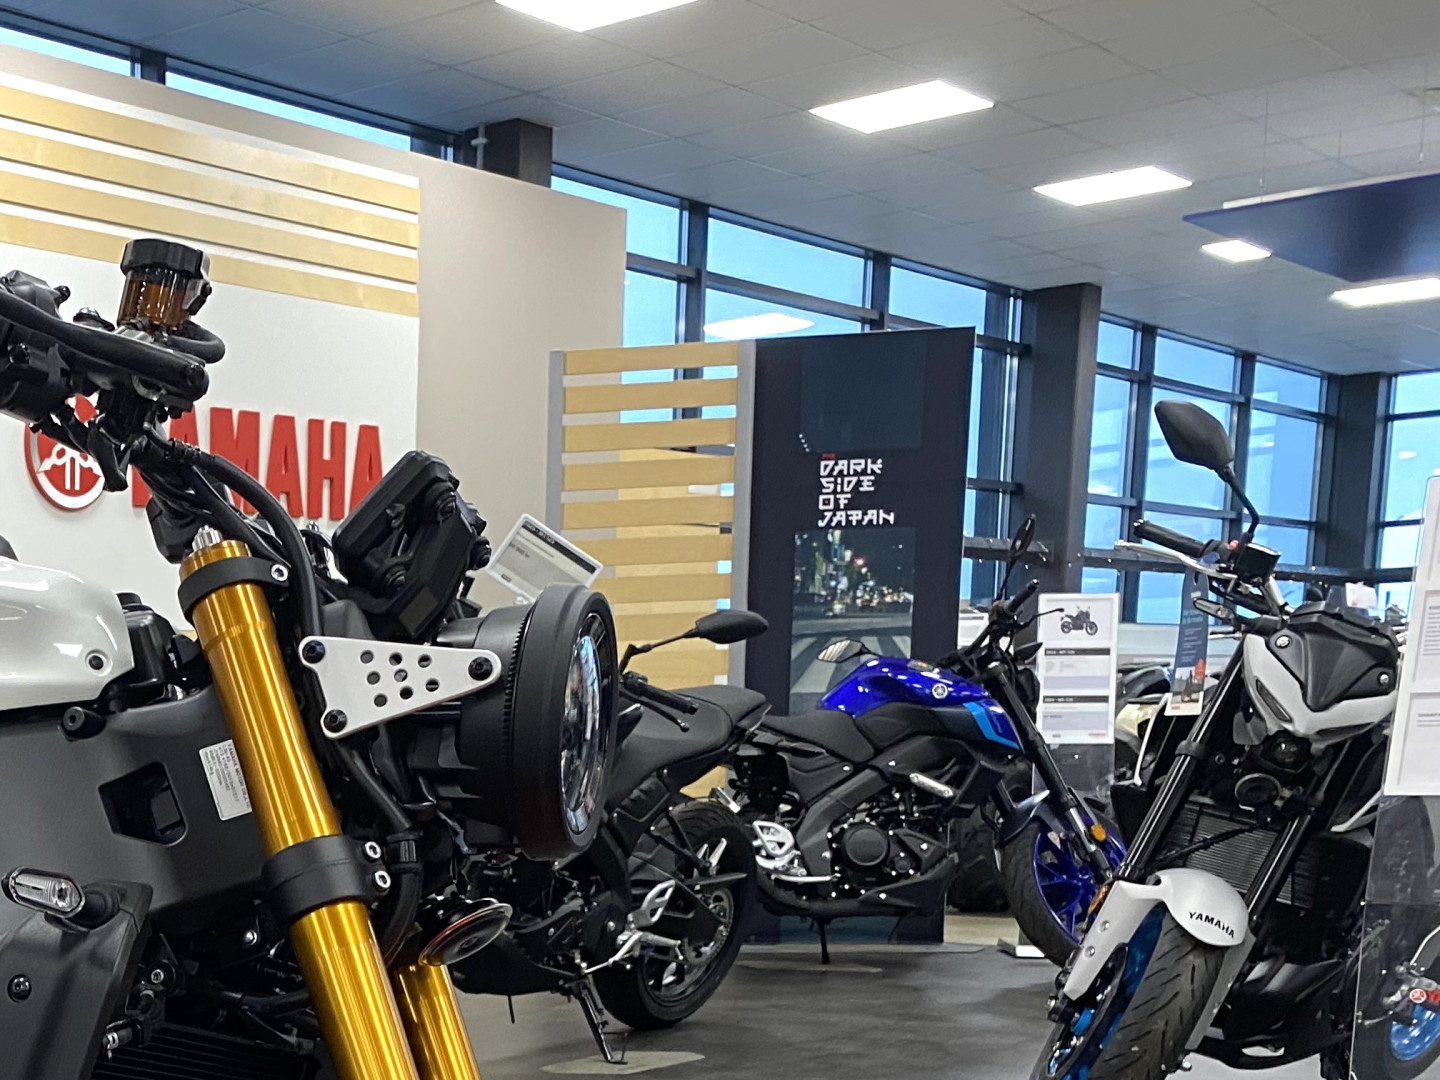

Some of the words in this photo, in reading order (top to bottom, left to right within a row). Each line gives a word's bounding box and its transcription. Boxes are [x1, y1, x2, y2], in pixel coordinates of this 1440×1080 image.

[819, 458, 883, 476] DARK
[819, 475, 876, 493] SIDE
[818, 493, 852, 511] OF
[817, 509, 895, 528] JAPAN
[1189, 912, 1235, 939] YAMAHA
